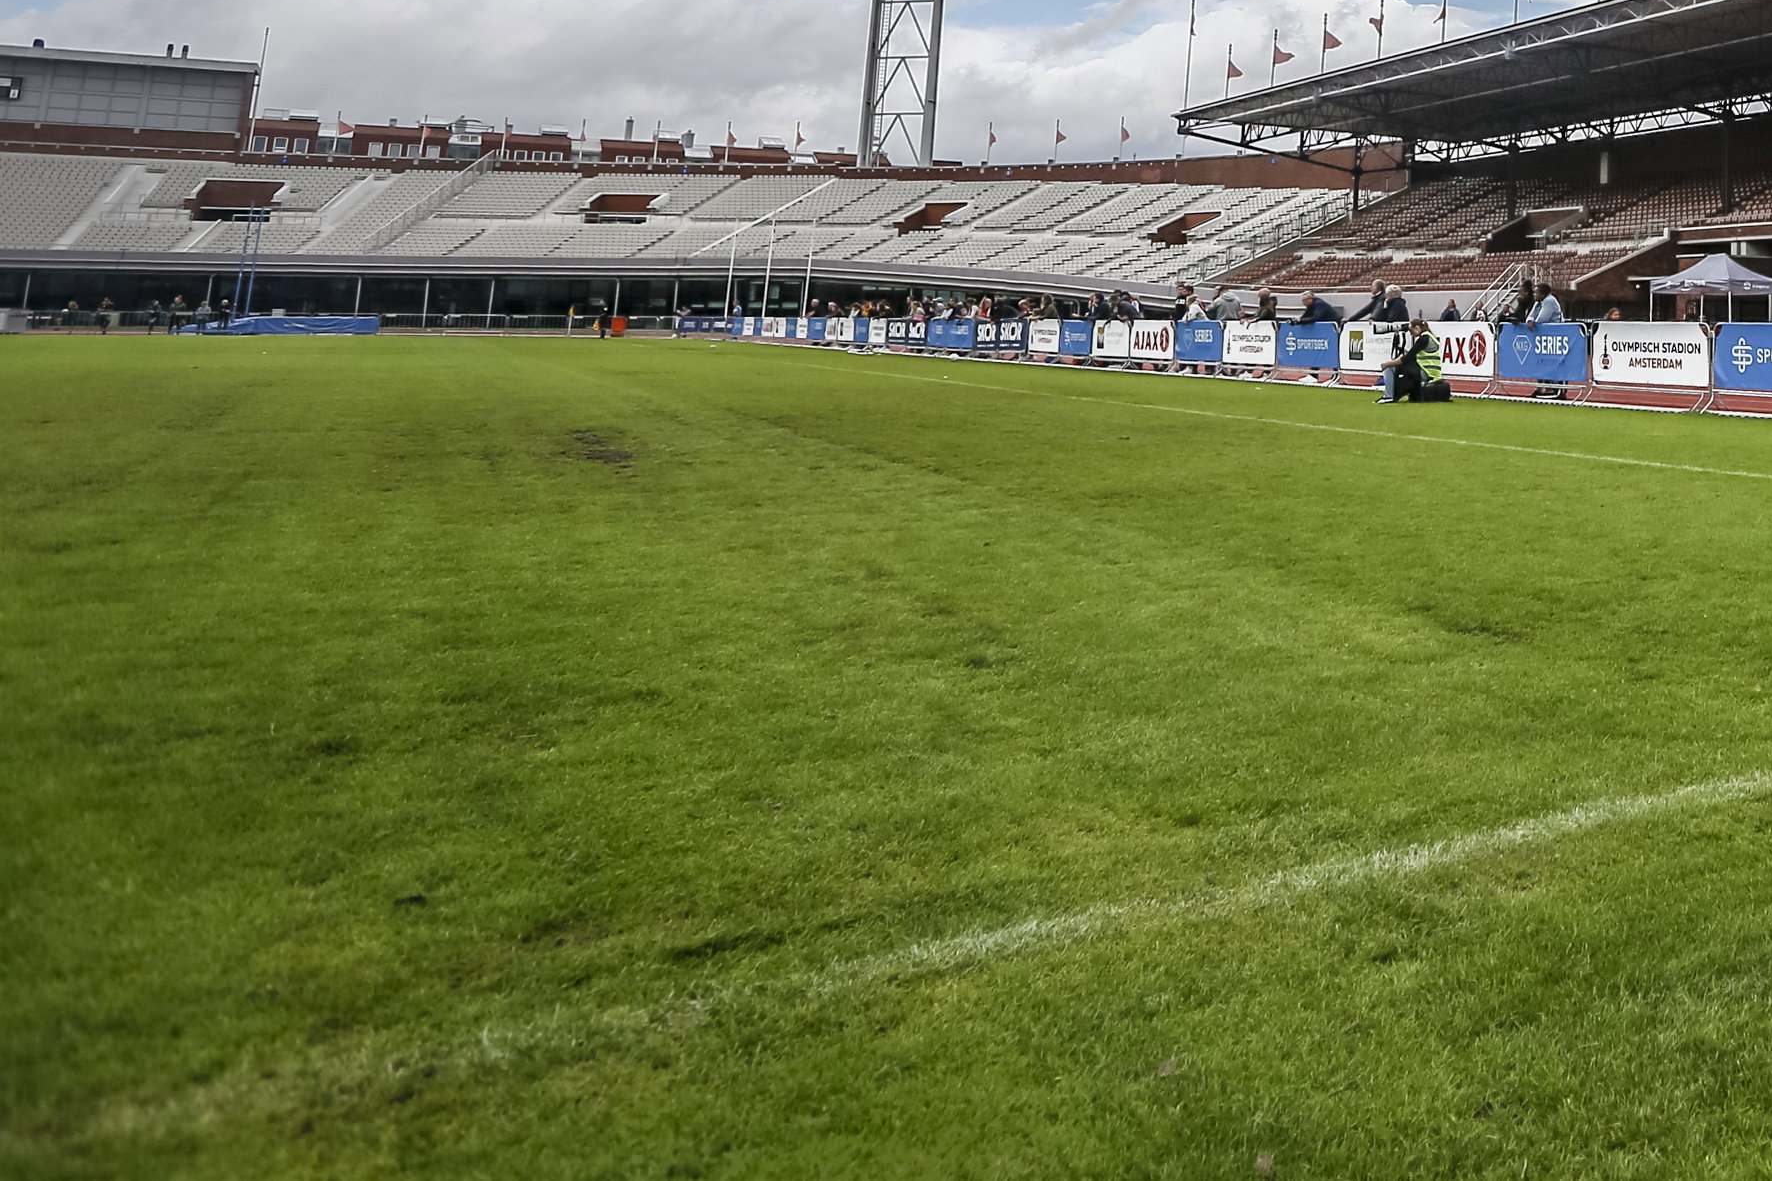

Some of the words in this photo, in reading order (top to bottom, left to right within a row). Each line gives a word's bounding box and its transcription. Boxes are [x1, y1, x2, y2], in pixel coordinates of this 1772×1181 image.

[977, 323, 996, 341] SKOR
[1000, 322, 1022, 341] SKOR
[1133, 330, 1158, 350] AJAX
[1297, 338, 1329, 350] SPORTSGEN
[1534, 335, 1569, 355] SERIES
[1611, 341, 1660, 353] OLYMPISCH
[1662, 342, 1700, 354] STADION
[1628, 357, 1683, 369] AMSTERDAM
